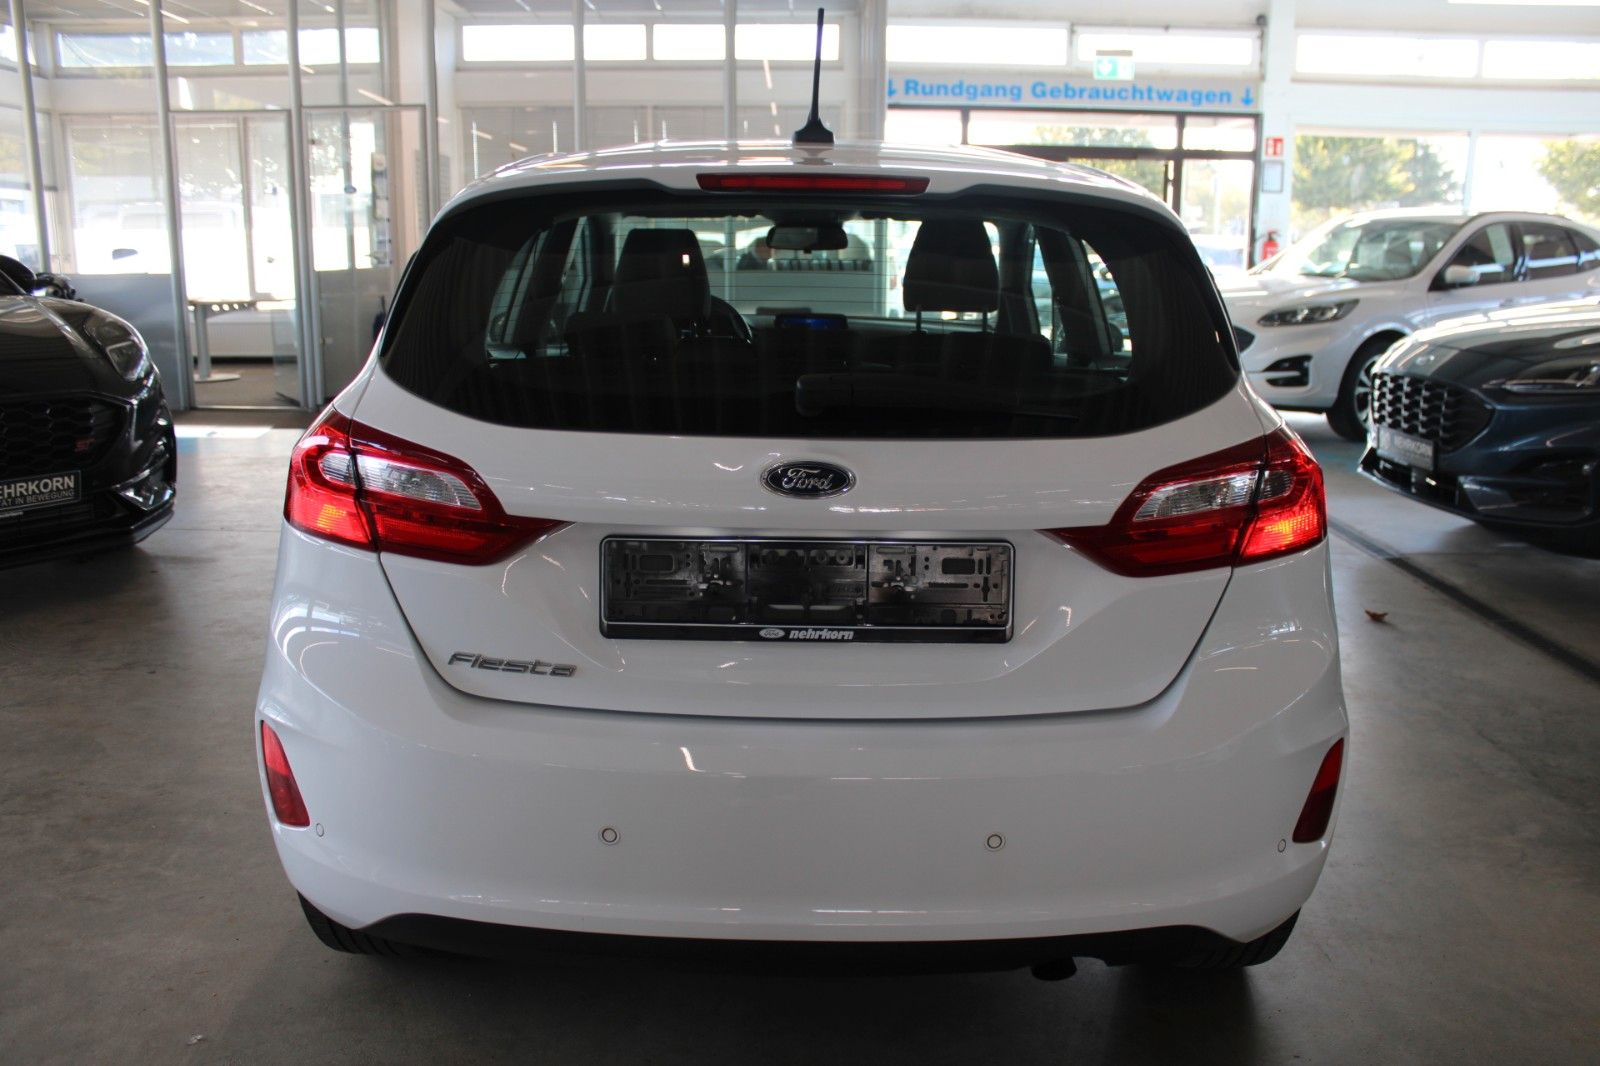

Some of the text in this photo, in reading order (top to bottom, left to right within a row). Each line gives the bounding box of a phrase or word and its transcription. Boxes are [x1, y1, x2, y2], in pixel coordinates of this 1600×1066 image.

[904, 79, 1232, 106] Rundgang Gebrauchtwagen
[782, 467, 834, 490] Ford
[26, 488, 75, 504] BEWEGUNG
[788, 628, 854, 640] nehrkorn
[448, 652, 578, 677] Fiesta
